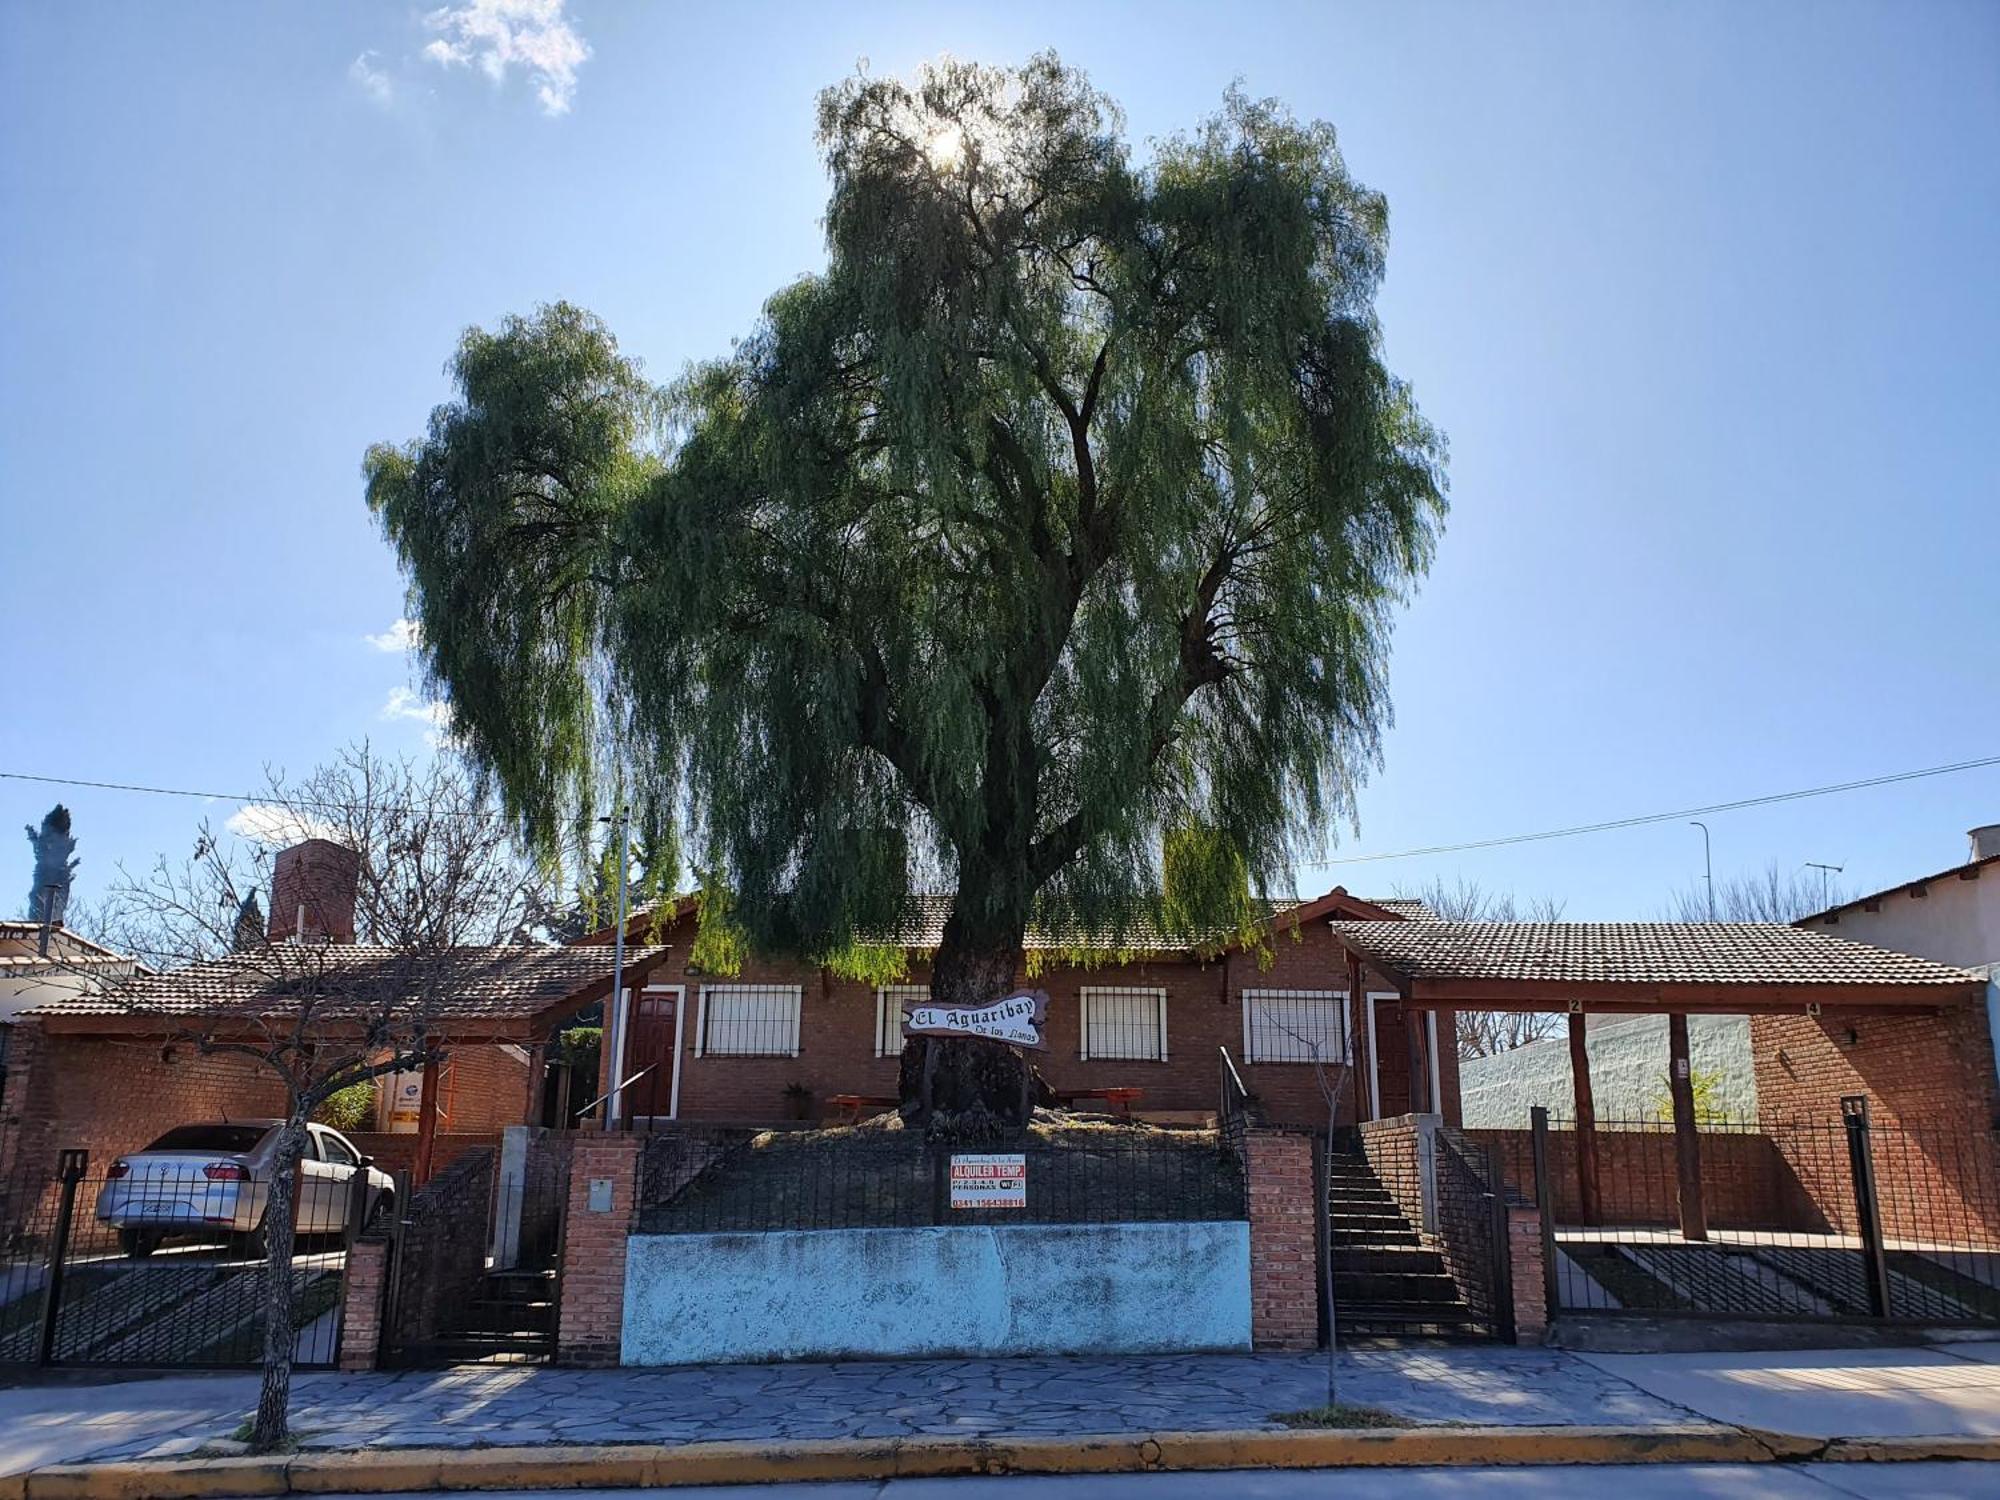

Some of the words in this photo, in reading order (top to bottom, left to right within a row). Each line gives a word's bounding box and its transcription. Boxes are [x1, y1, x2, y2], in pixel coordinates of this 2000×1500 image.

[1570, 999, 1579, 1011] 2
[916, 1011, 936, 1025] El
[946, 1000, 1034, 1028] Aguaribay
[954, 1166, 994, 1178] ALQUILER
[997, 1166, 1023, 1177] TEMP.
